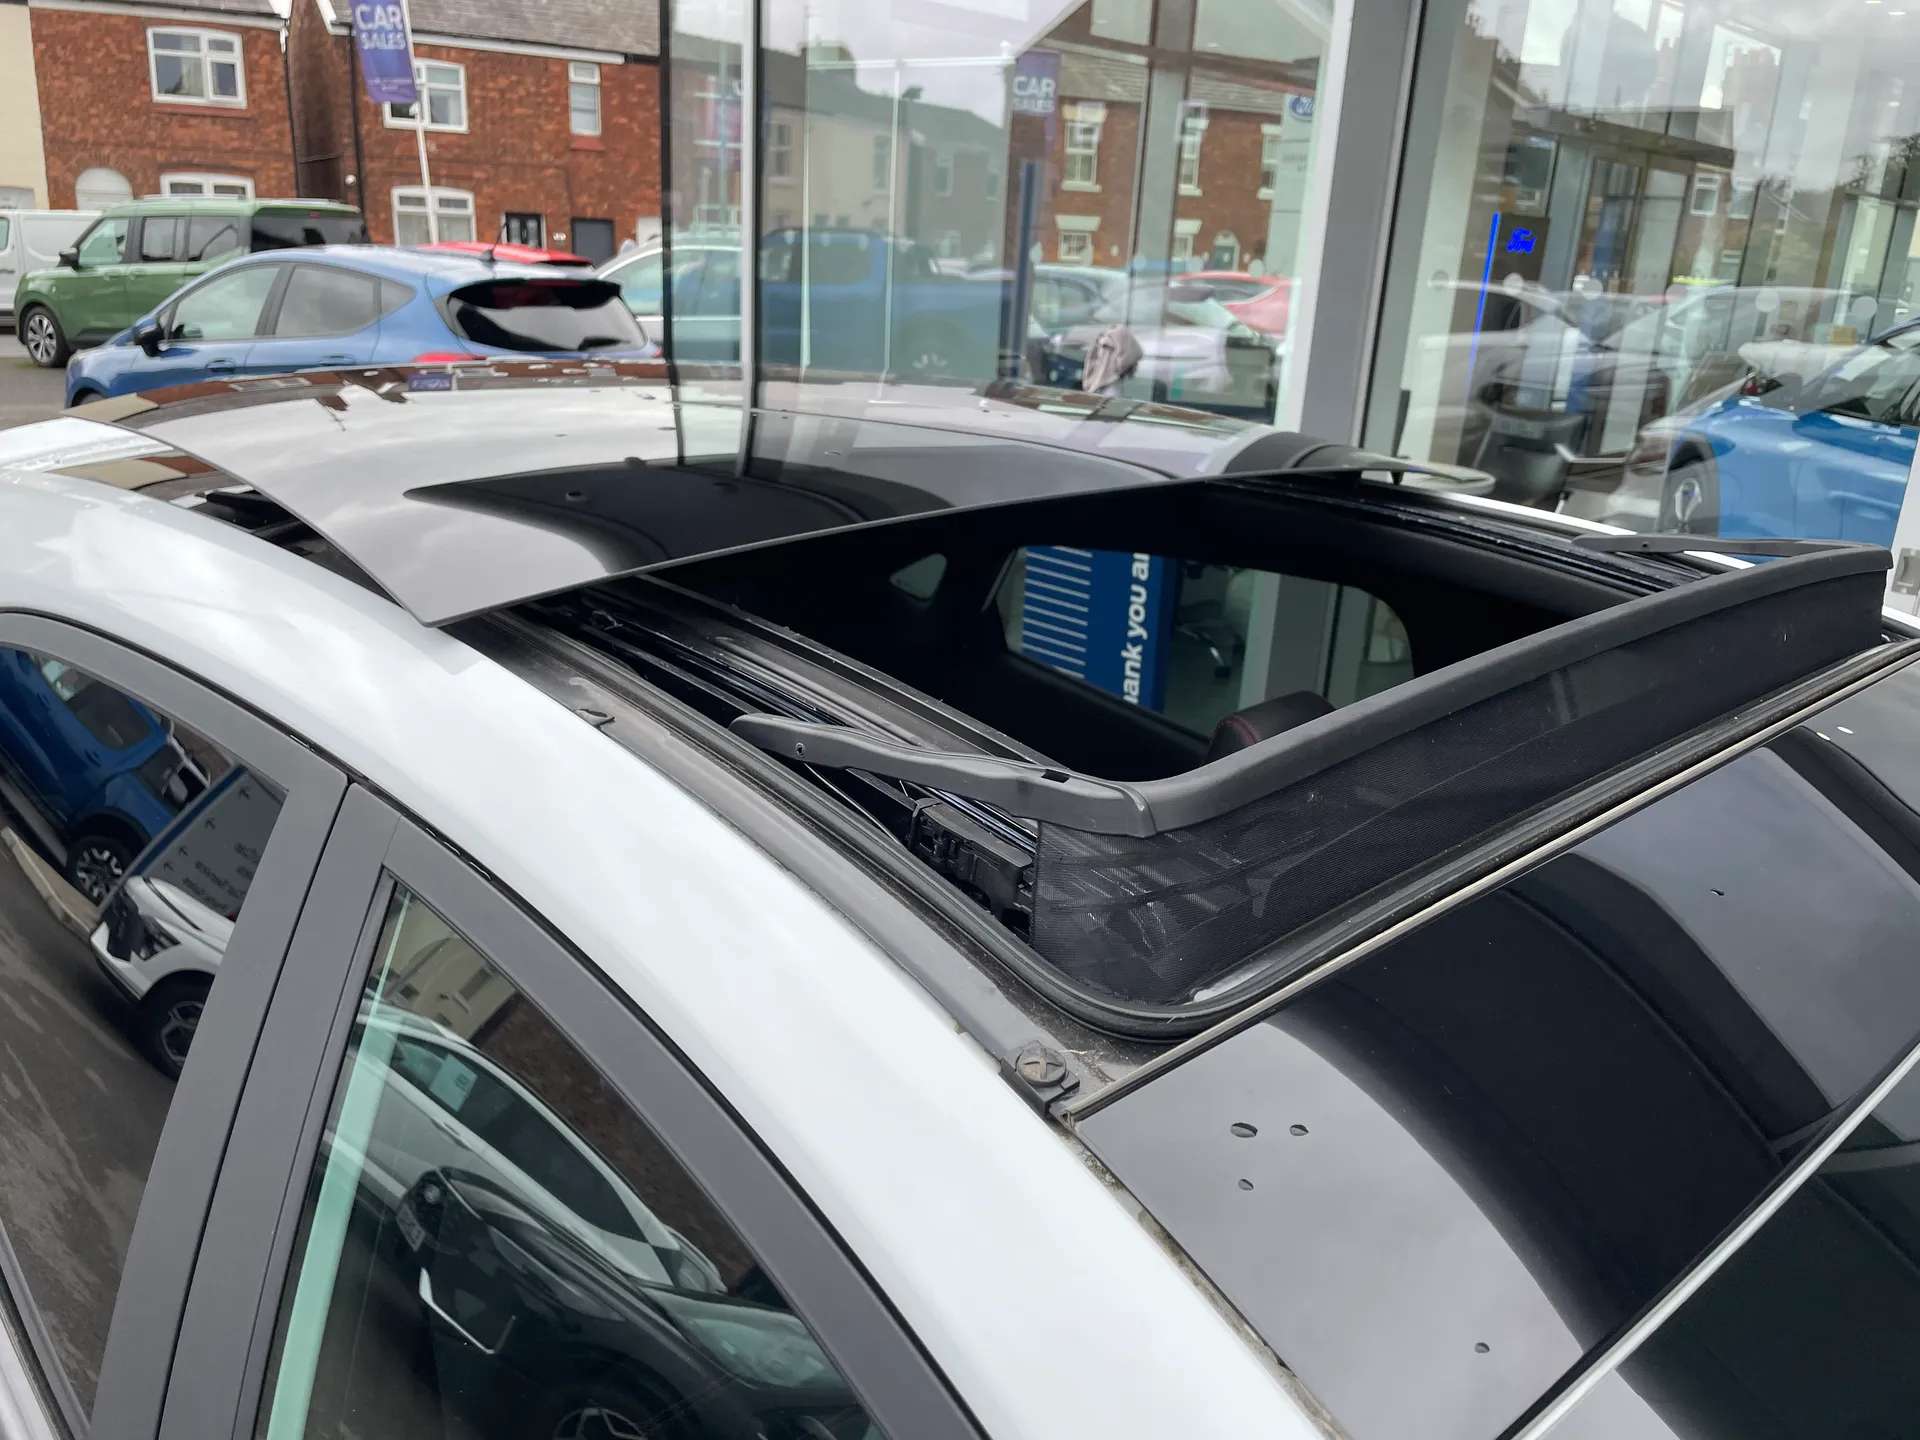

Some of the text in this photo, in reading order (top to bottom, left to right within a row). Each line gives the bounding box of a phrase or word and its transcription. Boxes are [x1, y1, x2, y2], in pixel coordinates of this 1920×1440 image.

[355, 4, 403, 31] CAR
[361, 31, 406, 50] SALES
[1013, 76, 1056, 98] CAR
[1127, 584, 1148, 640] you
